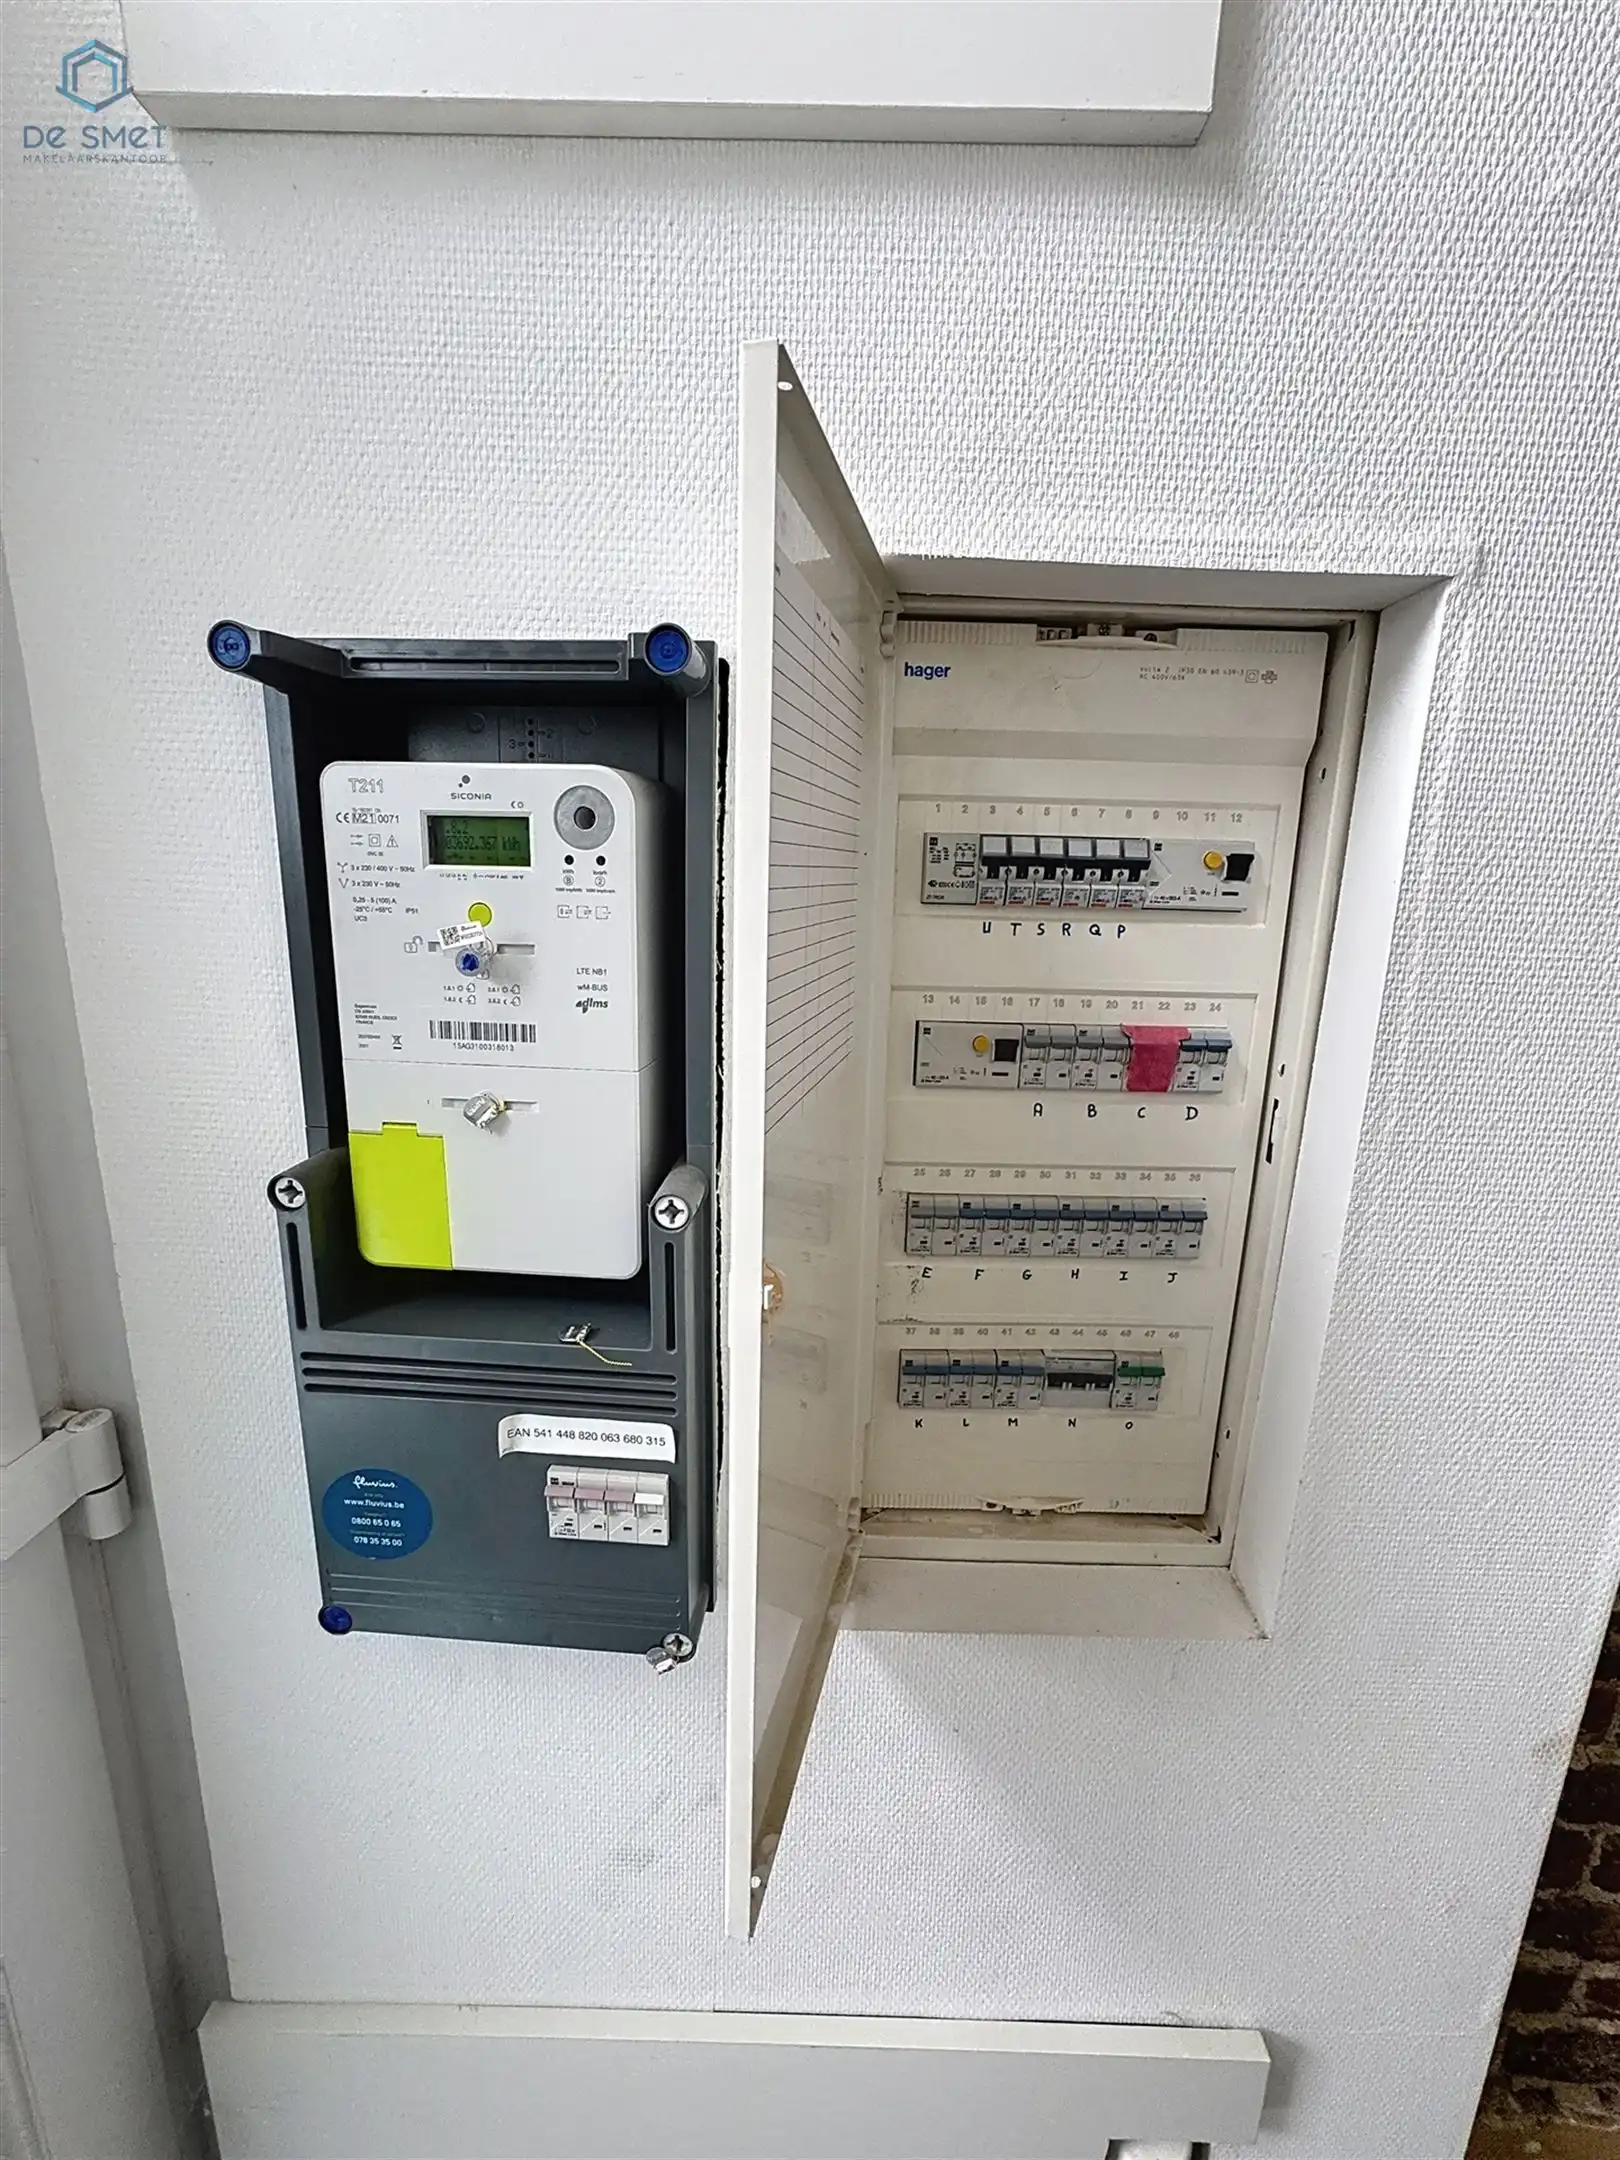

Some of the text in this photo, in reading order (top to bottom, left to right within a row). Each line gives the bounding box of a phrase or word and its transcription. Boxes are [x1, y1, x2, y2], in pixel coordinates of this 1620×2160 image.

[904, 661, 951, 680] hager
[348, 778, 384, 793] T211
[450, 792, 492, 800] SICONIA
[378, 814, 400, 824] 0071
[936, 804, 940, 812] 1
[962, 805, 968, 814] 2
[990, 805, 996, 814] 3
[1016, 806, 1024, 816] 4
[1044, 806, 1050, 816] 5
[1098, 808, 1106, 818] 7
[1176, 811, 1188, 820] 10
[1204, 812, 1216, 822] 11
[1231, 813, 1242, 822] 12
[982, 922, 1126, 938] U T S R Q P
[576, 968, 608, 976] LTE NB1
[922, 994, 934, 1004] 13
[949, 996, 960, 1004] 14
[1029, 998, 1040, 1006] 17
[1106, 1000, 1118, 1009] 20
[1132, 1002, 1144, 1010] 21
[1158, 1002, 1170, 1010] 22
[1184, 1002, 1196, 1011] 23
[1209, 1003, 1222, 1012] 24
[1033, 1102, 1198, 1120] A B C D
[964, 1170, 976, 1178] 27
[922, 1267, 1178, 1283] E F G H I J
[915, 1418, 923, 1428] K
[962, 1418, 970, 1426] L
[1008, 1418, 1018, 1426] M
[1068, 1418, 1076, 1428] N
[507, 1428, 666, 1446] EAN 541 448 820 063 680 315
[344, 1499, 404, 1508] www.fluvius.be
[352, 1517, 371, 1525] 0800
[354, 1536, 368, 1544] 078
[392, 1538, 402, 1546] 00
